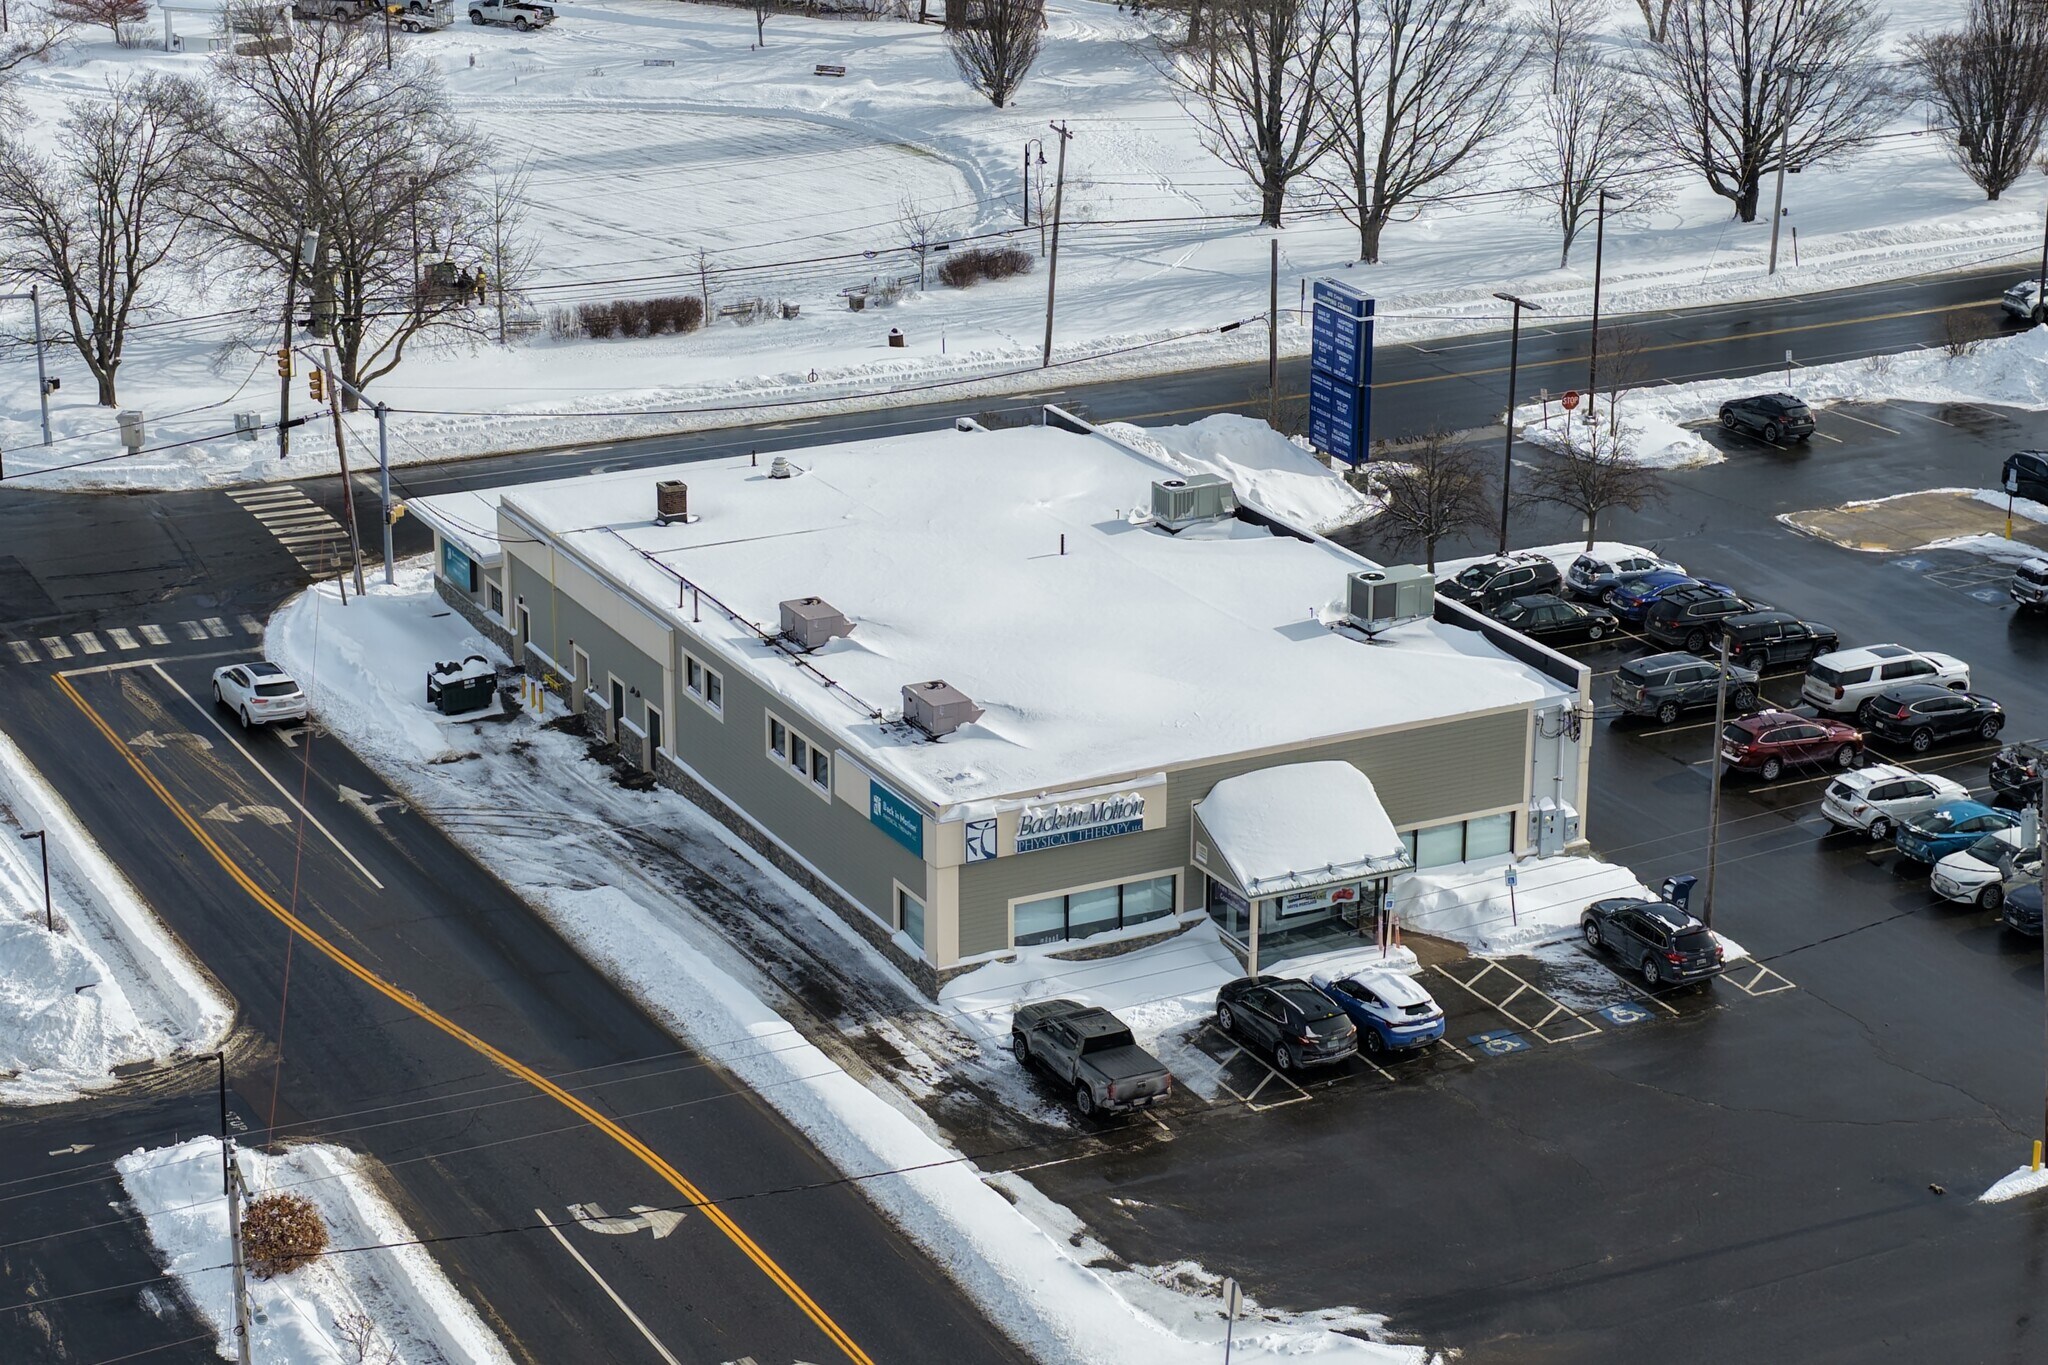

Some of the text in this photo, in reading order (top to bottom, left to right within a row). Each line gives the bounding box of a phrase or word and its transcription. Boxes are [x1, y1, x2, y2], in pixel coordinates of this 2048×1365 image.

[1317, 293, 1353, 313] SHOPPING CENTER
[1562, 396, 1579, 406] STOP
[882, 801, 894, 817] Back
[900, 813, 917, 833] Motion
[1018, 798, 1145, 837] Back in Motion
[1018, 832, 1071, 852] PHYSICAL
